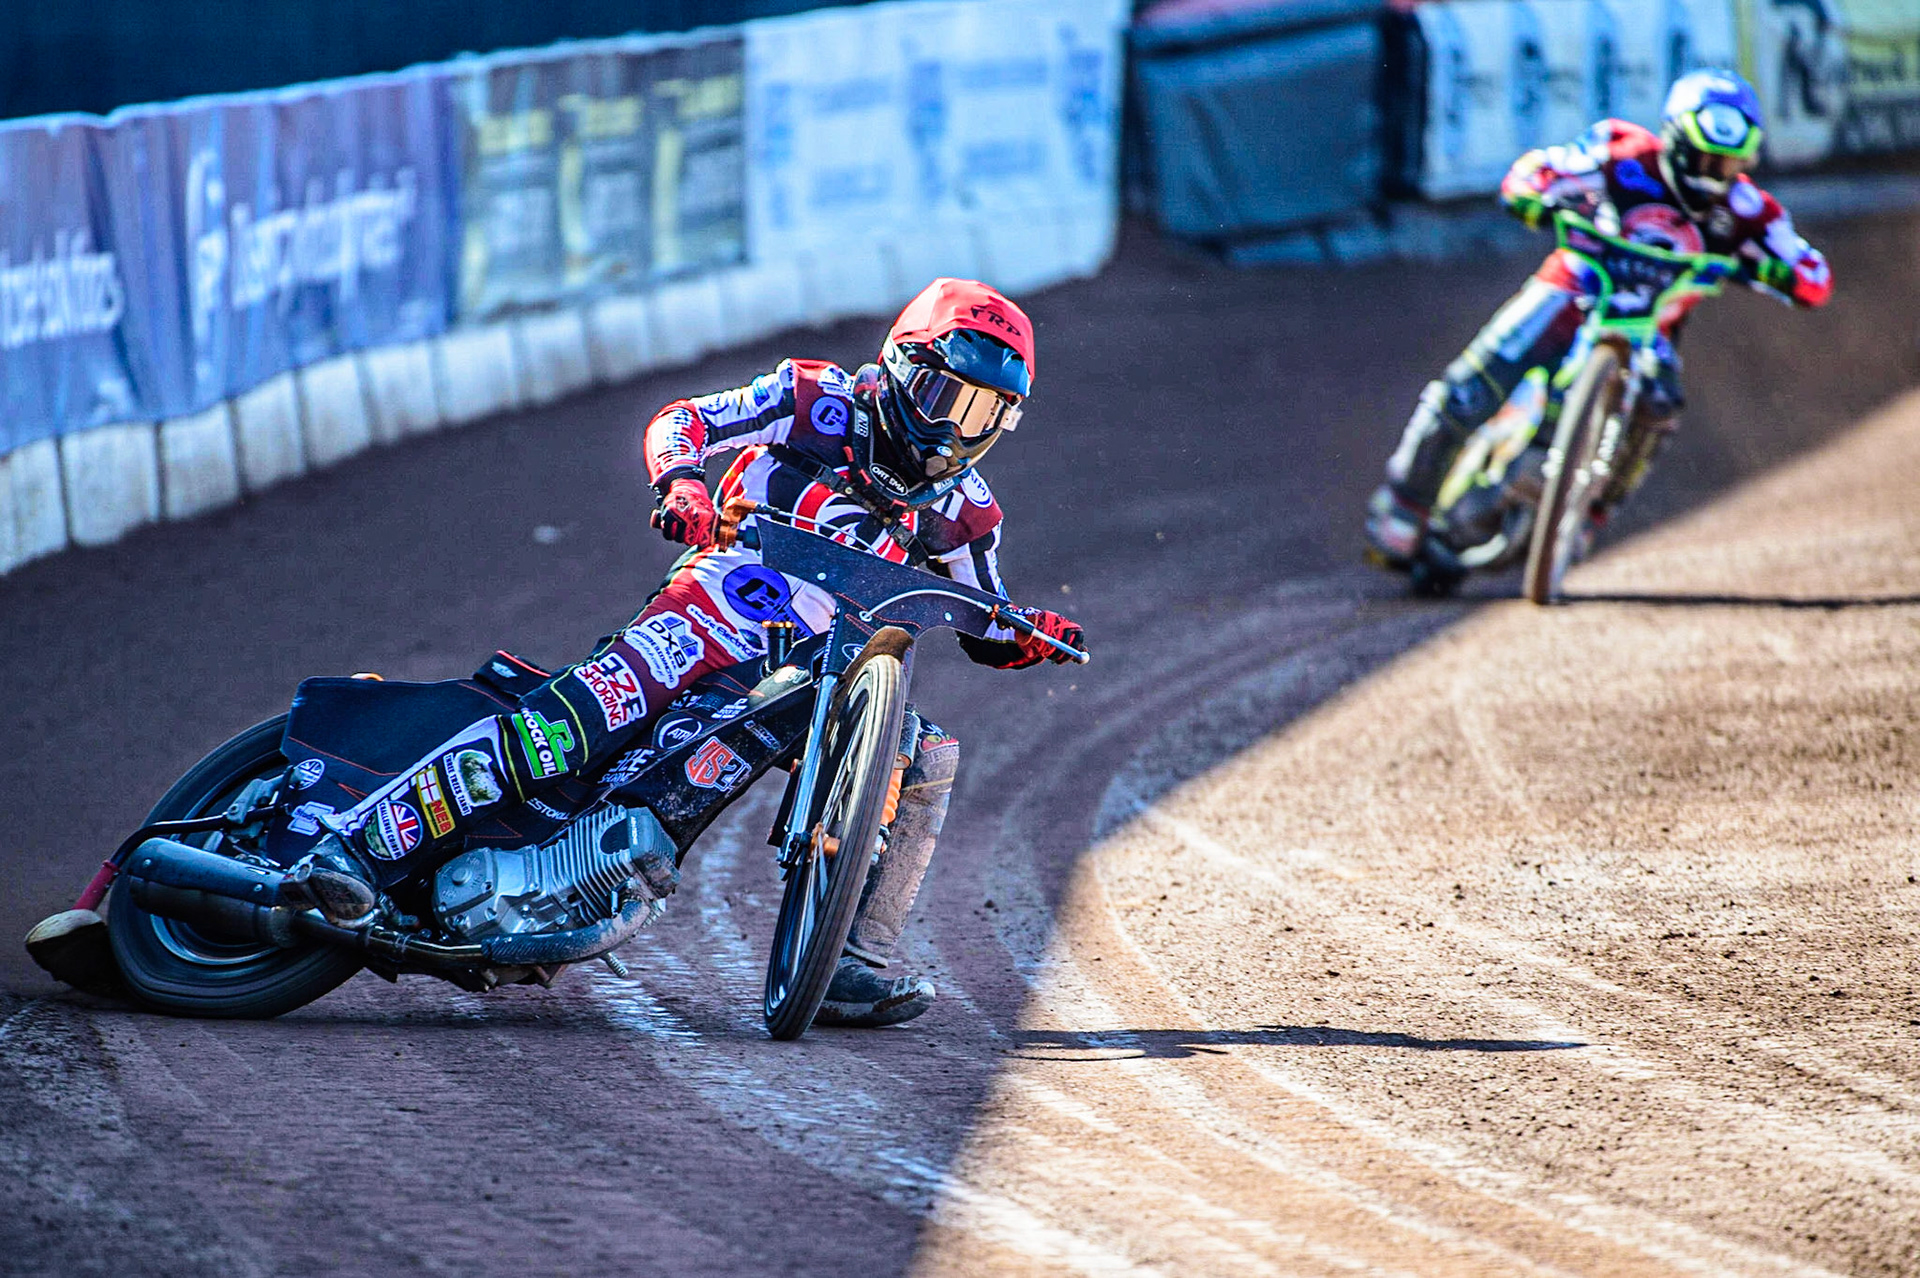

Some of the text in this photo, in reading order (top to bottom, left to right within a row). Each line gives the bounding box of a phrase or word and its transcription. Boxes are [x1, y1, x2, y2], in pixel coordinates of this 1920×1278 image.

[646, 620, 687, 669] DXB
[578, 668, 622, 728] SHORING
[591, 656, 643, 722] EZE
[539, 750, 557, 775] OIL
[450, 773, 463, 795] TREES
[430, 800, 452, 833] NEB
